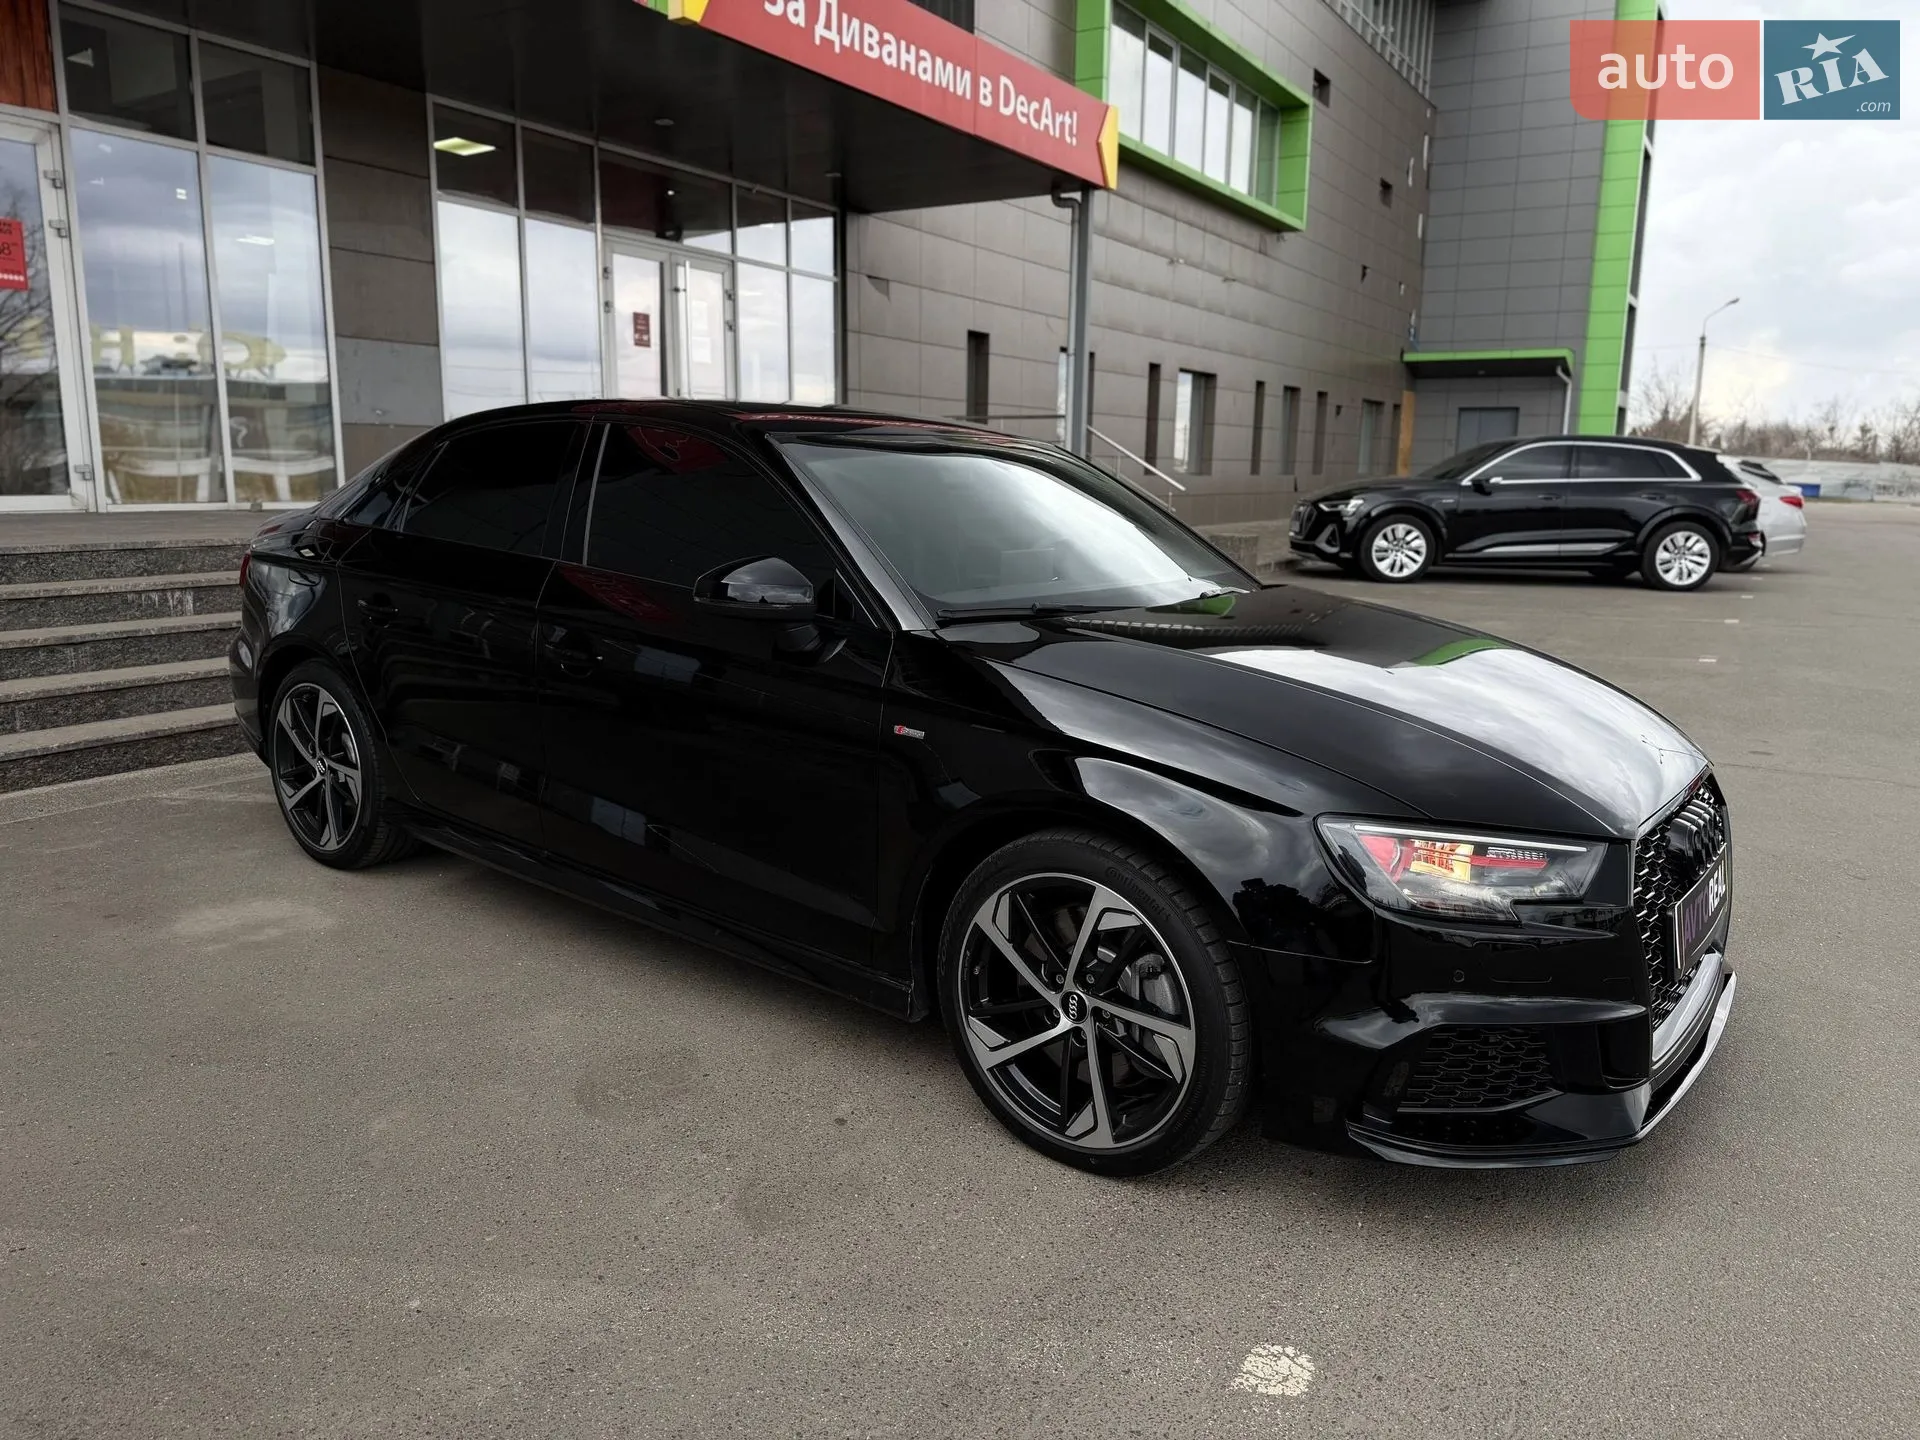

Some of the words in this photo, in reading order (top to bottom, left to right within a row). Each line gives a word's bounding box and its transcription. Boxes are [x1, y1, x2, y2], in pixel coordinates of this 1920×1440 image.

[814, 0, 972, 100] Диванами
[978, 78, 994, 108] в
[998, 75, 1078, 147] DecArt!
